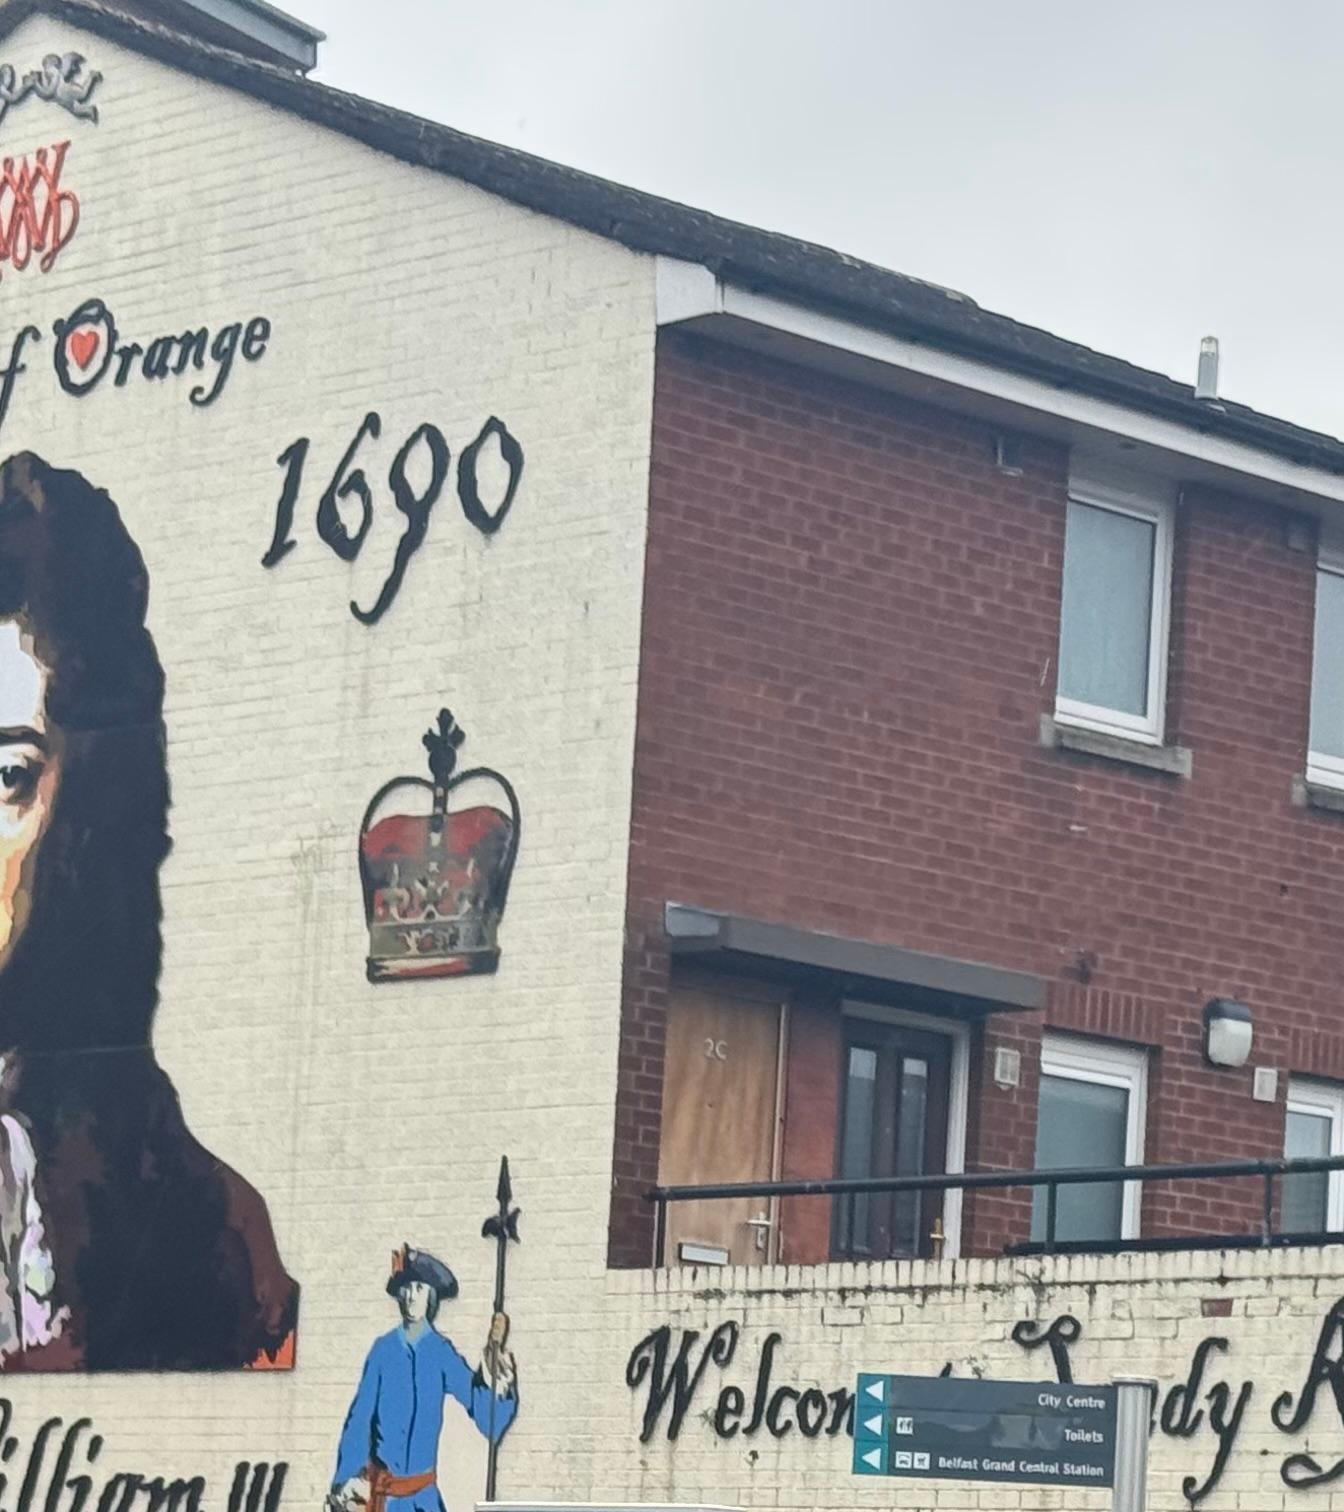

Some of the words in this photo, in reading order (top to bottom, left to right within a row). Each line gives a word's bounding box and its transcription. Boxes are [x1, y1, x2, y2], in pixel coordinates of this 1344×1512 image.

[55, 298, 272, 406] Orange
[261, 411, 524, 625] 1690
[1038, 1392, 1061, 1408] City
[1067, 1396, 1106, 1410] Centre
[1064, 1429, 1104, 1444] Toilets
[938, 1456, 978, 1471] Belfast
[982, 1460, 1015, 1473] Grand
[1019, 1461, 1059, 1475] Central
[1063, 1463, 1104, 1477] Station
